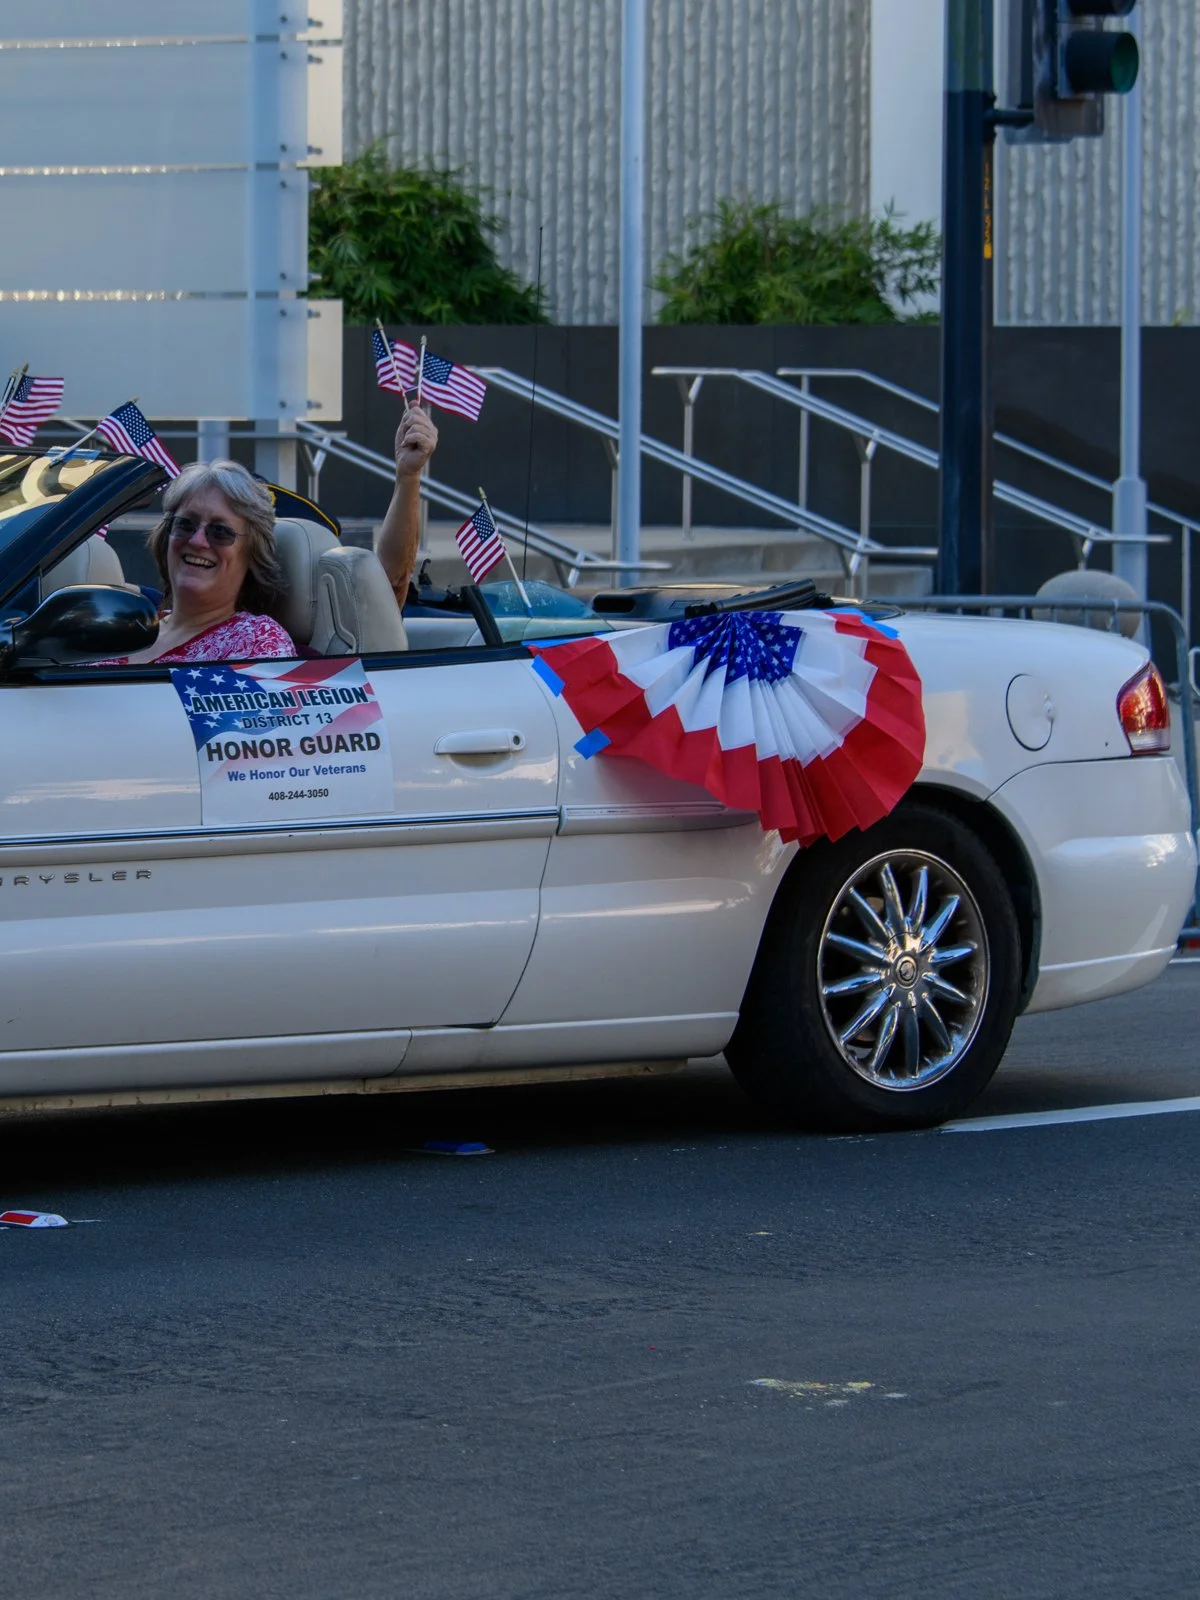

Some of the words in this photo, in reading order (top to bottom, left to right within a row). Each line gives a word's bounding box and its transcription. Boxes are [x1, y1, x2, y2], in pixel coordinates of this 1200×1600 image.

[191, 691, 300, 714] AMERICAN
[300, 686, 368, 707] LEGION
[242, 713, 310, 729] DISTRICT
[315, 712, 333, 724] 13
[206, 738, 293, 762] HONOR
[300, 732, 381, 755] GUARD
[227, 770, 246, 782] We
[249, 769, 285, 780] Honor
[289, 766, 310, 777] Our
[313, 764, 366, 776] Veterans
[268, 788, 329, 801] 408-244-3050
